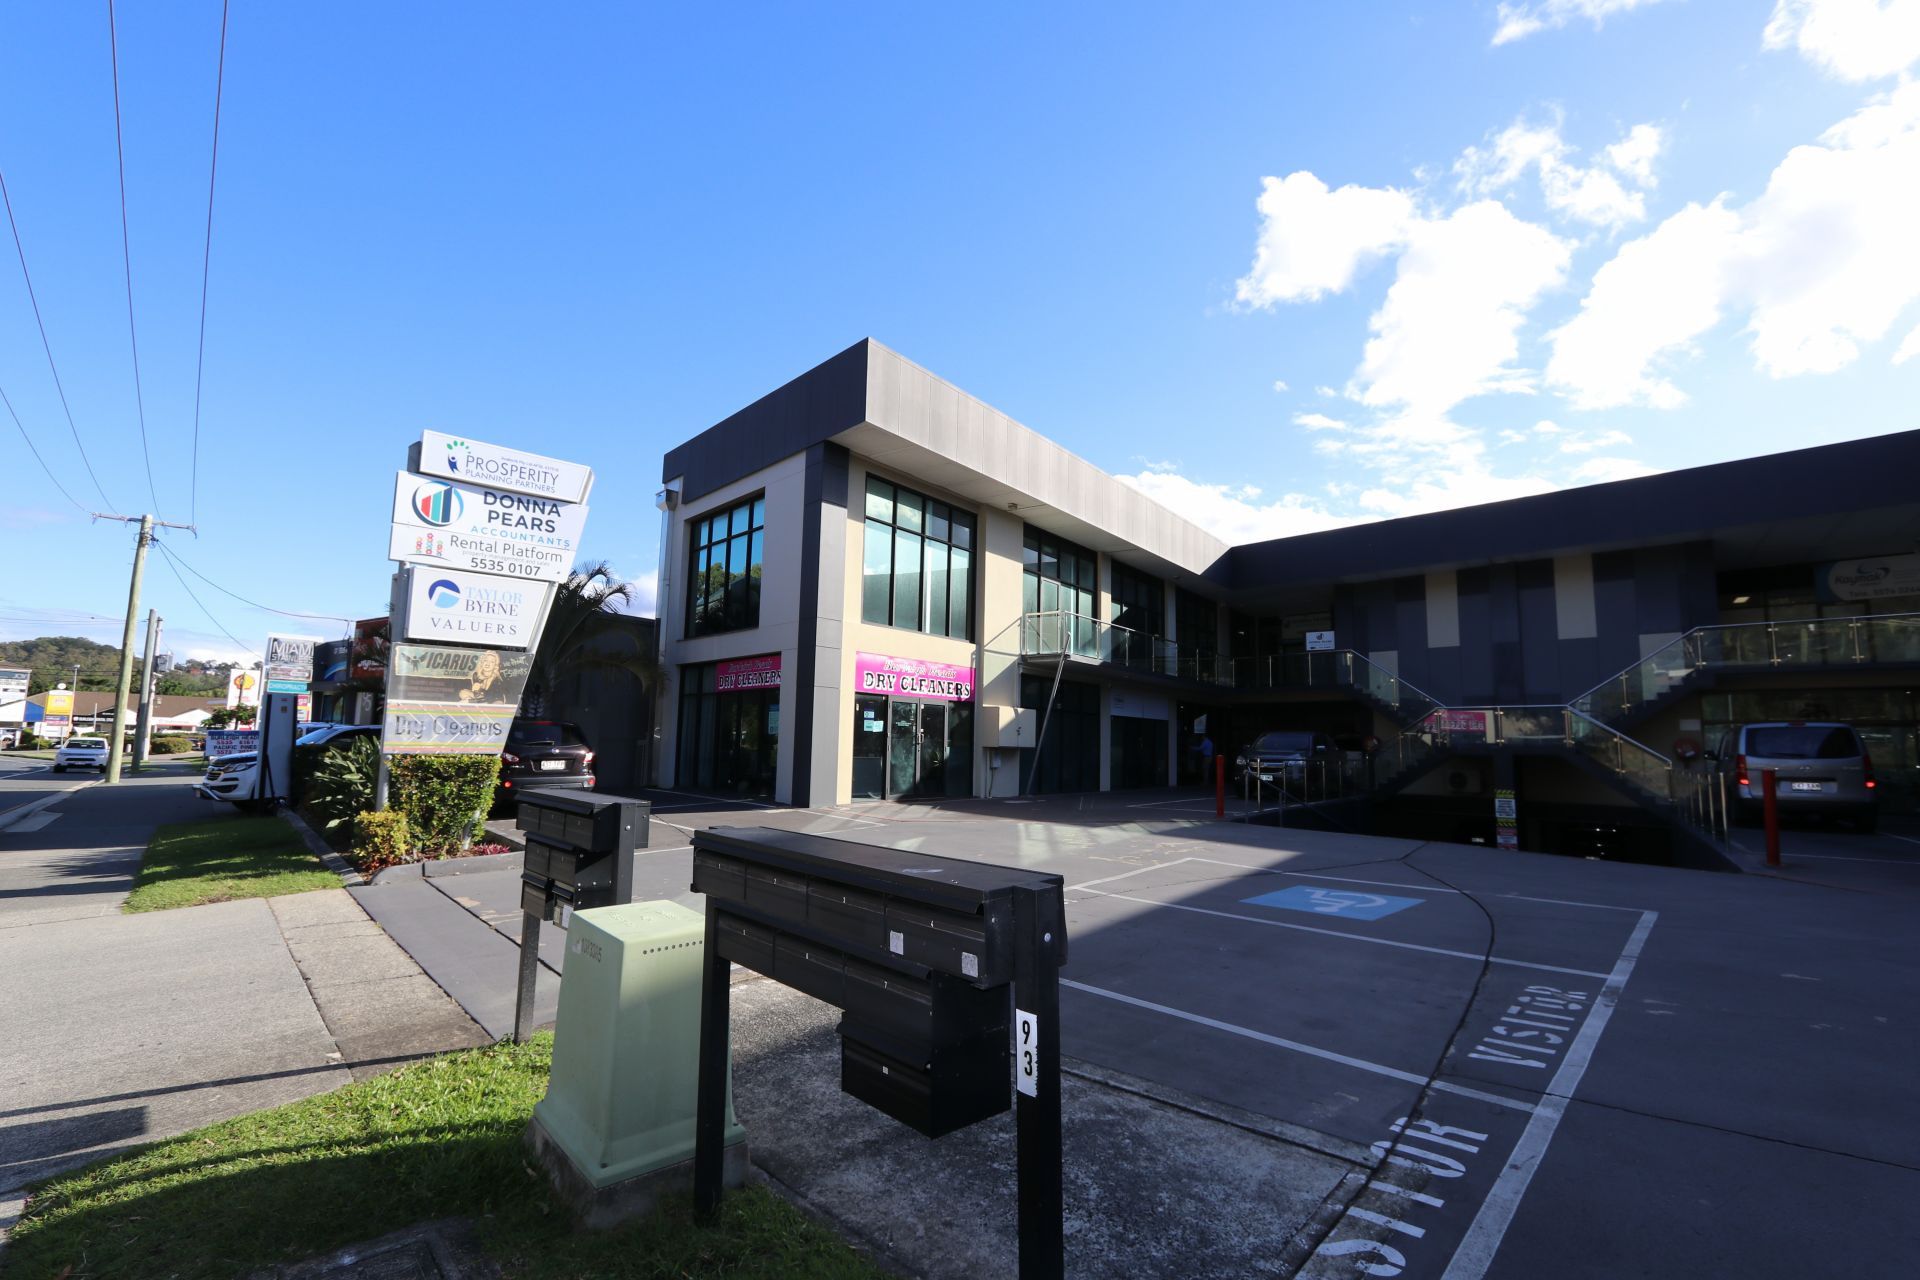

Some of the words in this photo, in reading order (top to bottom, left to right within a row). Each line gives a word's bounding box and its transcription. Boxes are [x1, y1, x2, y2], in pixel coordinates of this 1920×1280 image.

[465, 455, 559, 486] PROSPERITY
[465, 469, 512, 485] PLANNING
[515, 479, 556, 494] PARTNERS
[483, 491, 561, 517] DONNA
[487, 510, 556, 533] PEARS
[470, 525, 571, 547] ACCOUNTANTS
[450, 535, 497, 554] Rental
[503, 543, 563, 563] Platform
[470, 557, 504, 572] 5535
[508, 561, 541, 576] 0107
[465, 586, 523, 604] TAYLOR
[465, 599, 519, 617] BYRNE
[431, 617, 518, 635] VALUERS
[272, 641, 314, 657] MIAMI
[426, 652, 479, 671] ICARUS
[719, 674, 736, 689] DRY
[864, 671, 896, 691] DRY
[900, 675, 971, 697] CLEANERS
[394, 715, 424, 739] Dry
[432, 716, 502, 736] Cleaners
[1466, 985, 1588, 1069] VISITOR
[1022, 1019, 1033, 1076] 93
